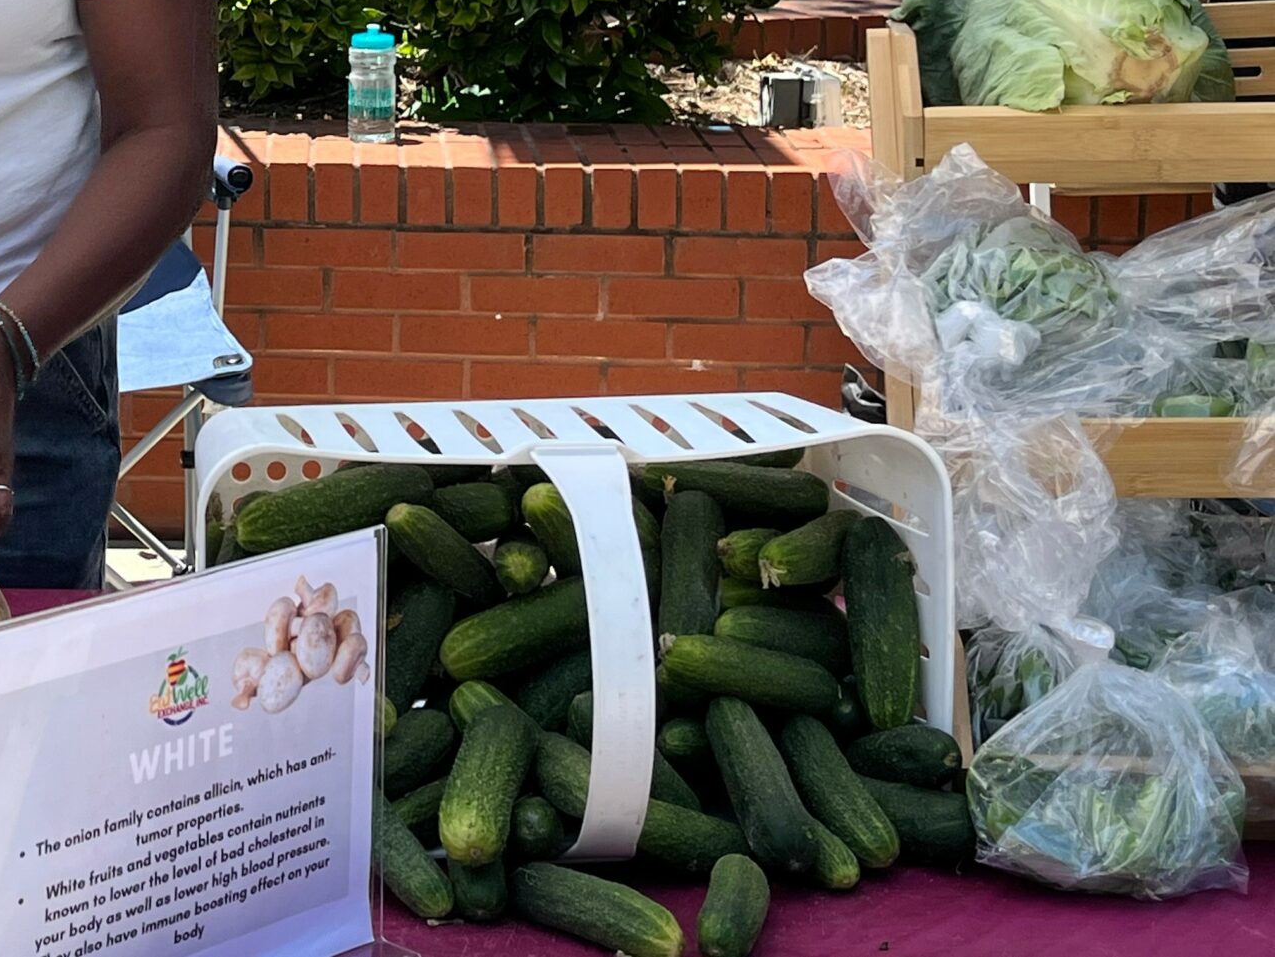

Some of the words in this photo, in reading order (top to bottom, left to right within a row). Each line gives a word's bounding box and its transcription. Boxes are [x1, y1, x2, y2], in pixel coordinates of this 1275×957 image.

[36, 839, 61, 856] The
[65, 828, 101, 847] onion
[104, 810, 143, 835] family
[146, 794, 200, 820] contains
[203, 779, 244, 801] allicin,
[247, 764, 283, 787] which
[286, 760, 307, 774] has
[310, 747, 337, 766] anti-
[129, 723, 233, 785] WHITE
[44, 900, 89, 923] known
[93, 894, 106, 907] to
[110, 881, 146, 901] lower
[149, 871, 169, 887] the
[172, 856, 202, 880] level
[205, 851, 218, 868] of
[221, 842, 245, 863] bad
[248, 817, 312, 853] cholesterol
[314, 816, 325, 829] in
[45, 878, 86, 900] White
[89, 866, 123, 886] fruits
[127, 851, 152, 873] and
[155, 831, 224, 862] vegetables
[227, 814, 272, 838] contain
[275, 795, 326, 822] nutrients
[135, 825, 173, 846] tumor
[176, 803, 244, 837] properties.
[34, 929, 65, 952] your
[69, 915, 103, 937] body
[106, 912, 122, 925] as
[125, 896, 153, 918] well
[155, 895, 171, 907] as
[174, 880, 209, 902] lower
[212, 867, 238, 888] high
[241, 852, 274, 877] blood
[277, 837, 331, 867] pressure.
[74, 940, 103, 957] also
[106, 928, 138, 947] have
[141, 910, 191, 935] immune
[194, 888, 247, 916] boosting
[250, 873, 286, 895] effect
[288, 867, 302, 880] on
[304, 856, 331, 879] your
[173, 923, 205, 944] body
